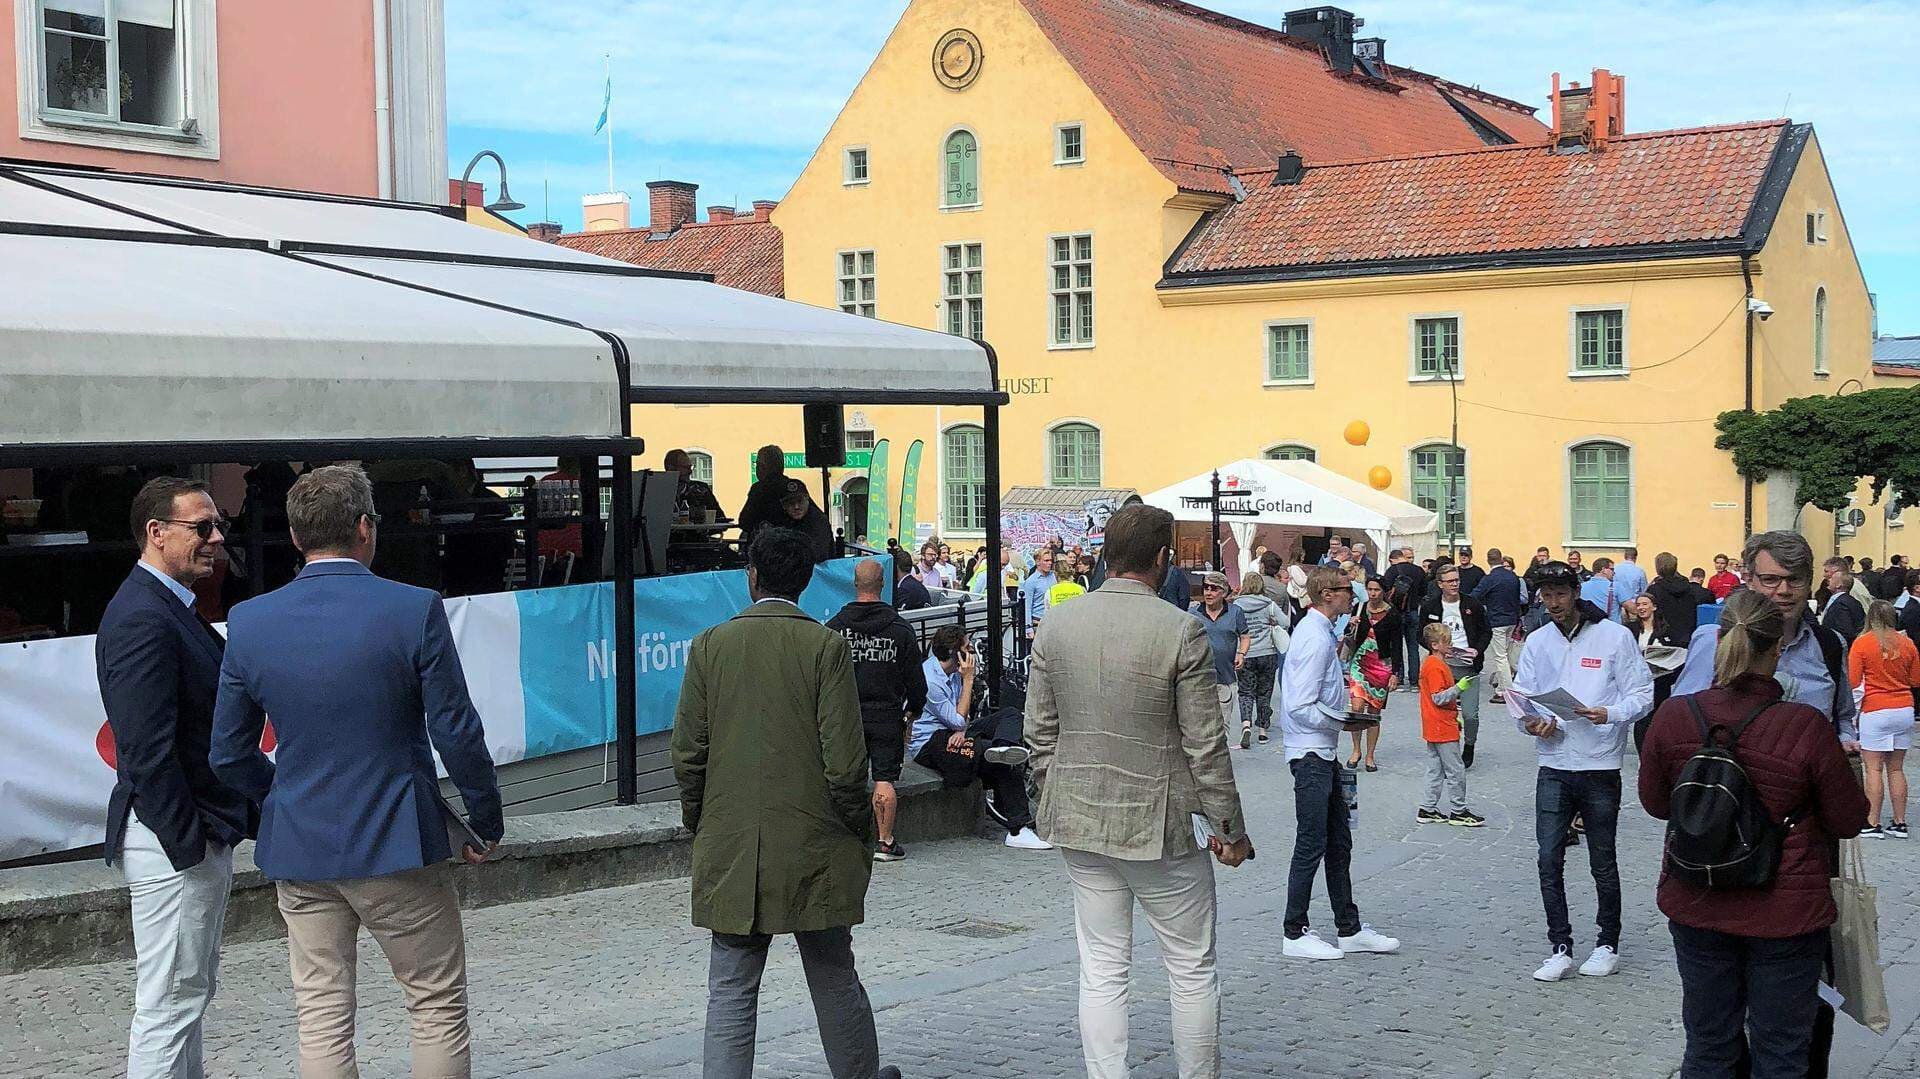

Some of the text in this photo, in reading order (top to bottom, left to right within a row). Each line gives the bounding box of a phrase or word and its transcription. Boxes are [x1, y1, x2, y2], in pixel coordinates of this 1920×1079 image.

[998, 377, 1053, 394] HUSET
[1255, 498, 1313, 514] Gotland
[848, 637, 895, 650] UMANITY
[851, 646, 898, 663] EHIND!
